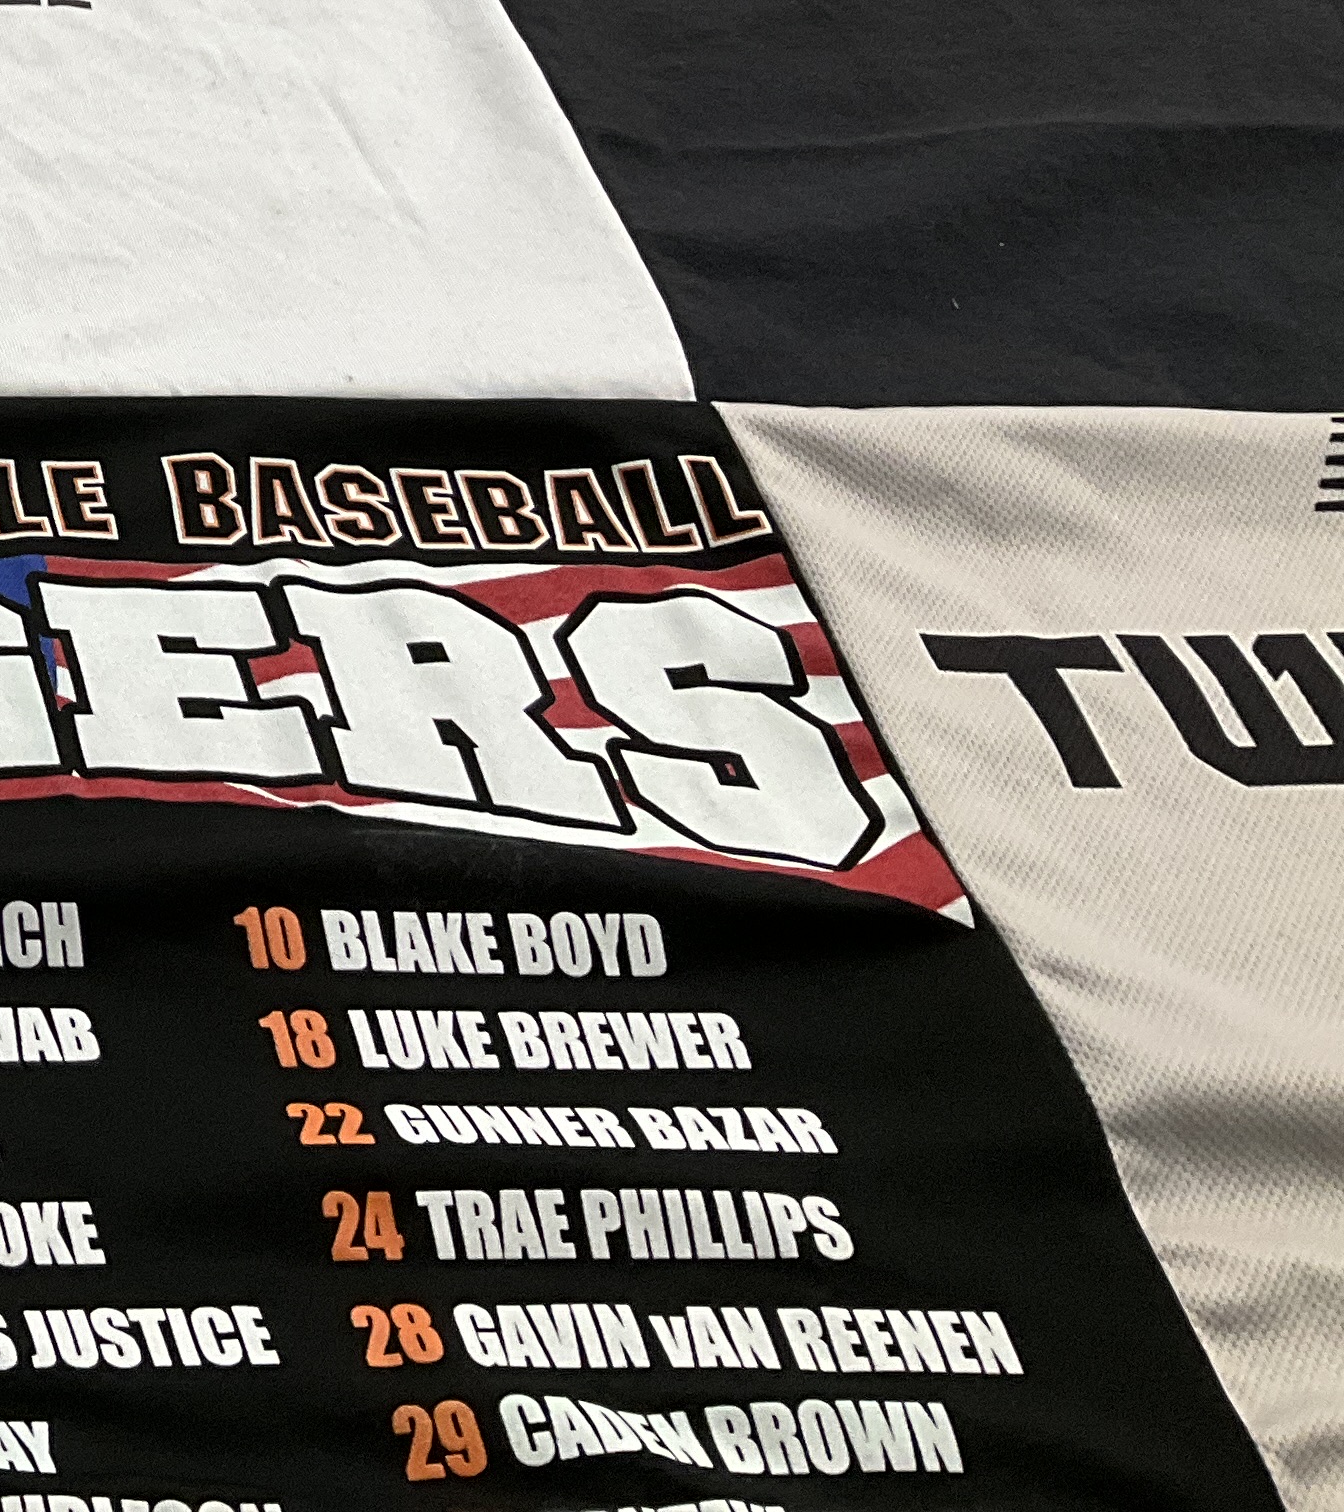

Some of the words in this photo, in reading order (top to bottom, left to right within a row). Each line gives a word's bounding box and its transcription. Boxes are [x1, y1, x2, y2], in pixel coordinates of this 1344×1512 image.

[161, 453, 773, 551] BASEBALL
[233, 906, 306, 971] 10
[319, 909, 504, 976] BLAKE
[515, 911, 668, 978] BOYD
[259, 1009, 336, 1068] 18
[346, 1009, 500, 1070] LUKE
[497, 1011, 752, 1071] BREWER
[284, 1102, 375, 1145] 22
[383, 1103, 636, 1148] GUNNER
[628, 1106, 839, 1155] BAZAR
[321, 1190, 405, 1263] 24
[415, 1189, 577, 1261] TRAE
[580, 1188, 855, 1261] PHILLIPS
[23, 1305, 280, 1370] JUSTICE
[349, 1303, 446, 1369] 28
[452, 1302, 651, 1371] GAVIN
[775, 1306, 1026, 1376] REENEN
[392, 1400, 489, 1481] 29
[499, 1394, 714, 1470] CADEN
[704, 1400, 964, 1475] BROWN
